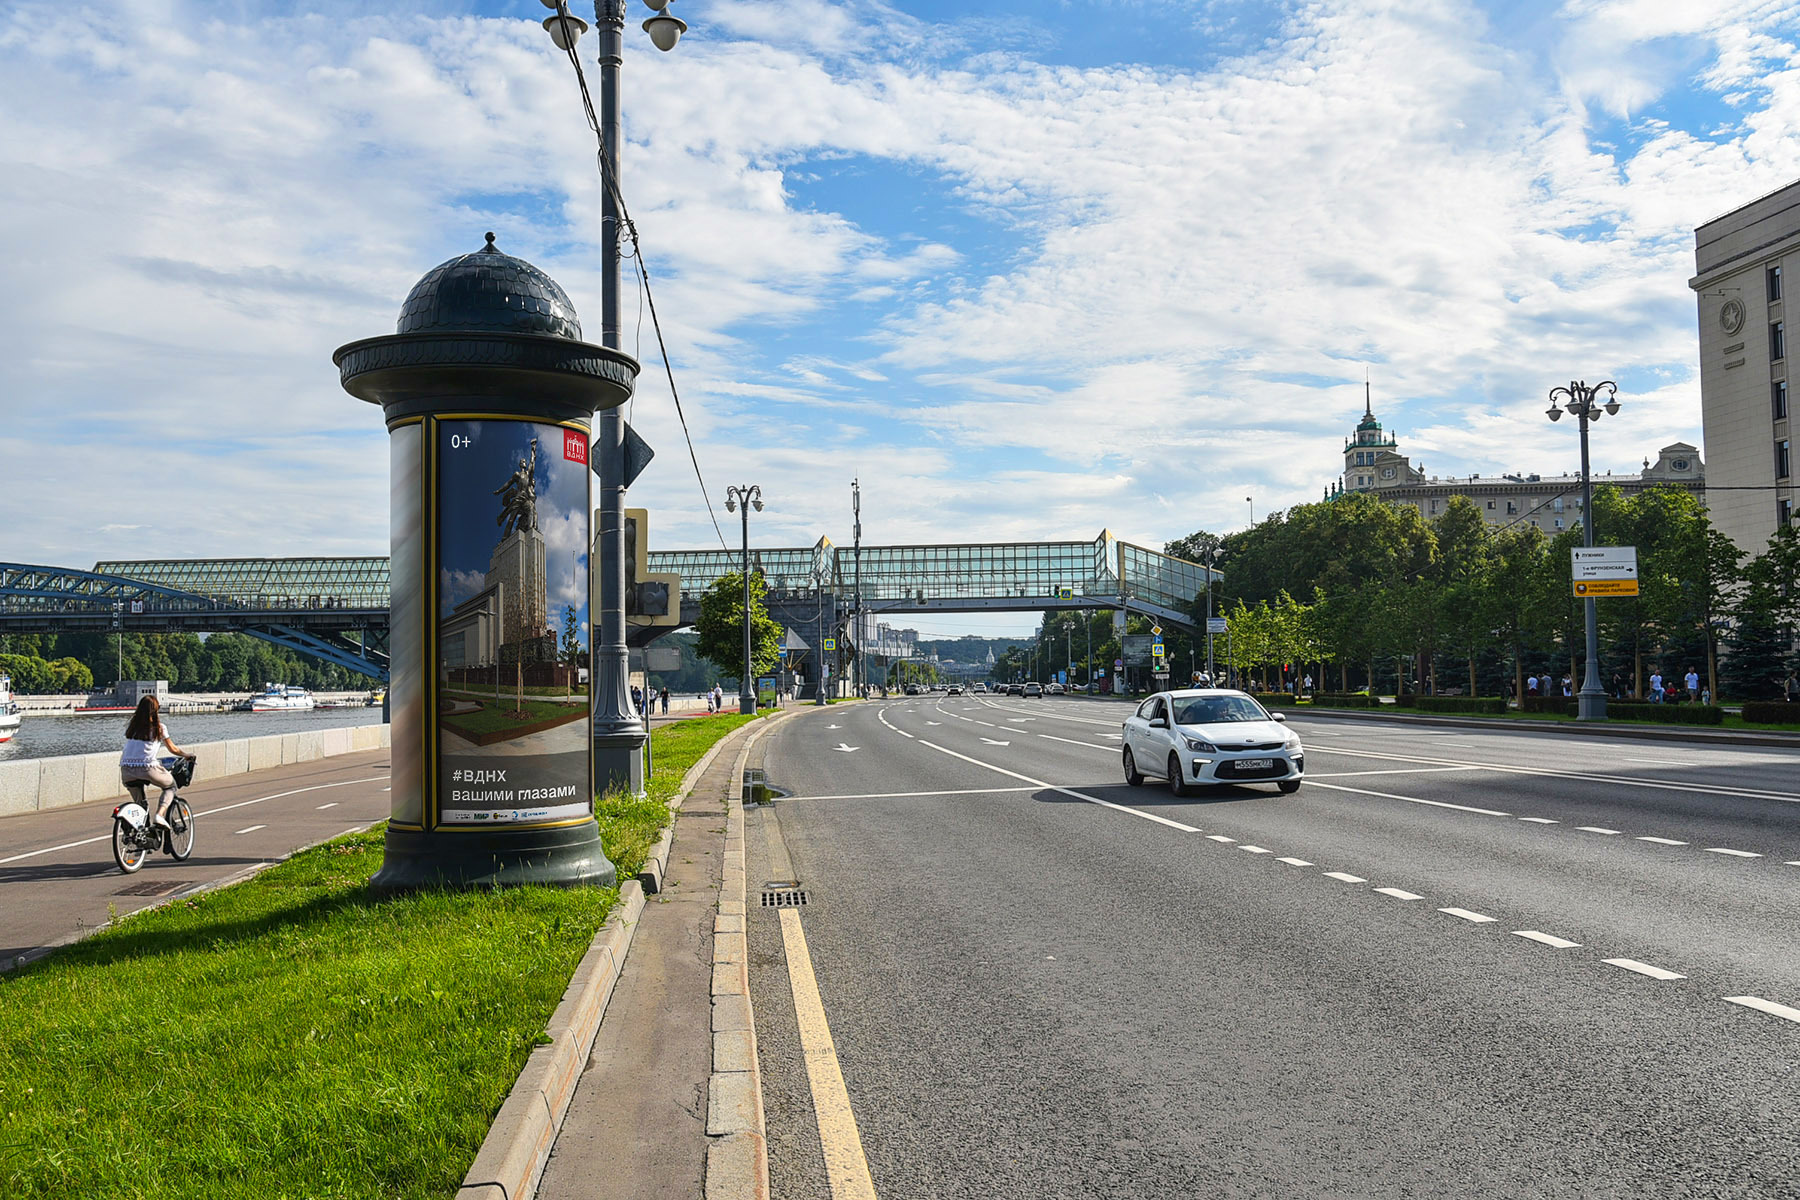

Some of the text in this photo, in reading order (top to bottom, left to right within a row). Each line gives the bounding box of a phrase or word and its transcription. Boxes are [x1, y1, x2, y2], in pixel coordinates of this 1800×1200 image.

[451, 434, 471, 449] 0+
[566, 451, 584, 460] ВДНХ
[452, 769, 507, 785] #ВДНХ
[452, 785, 576, 801] вашими глазами
